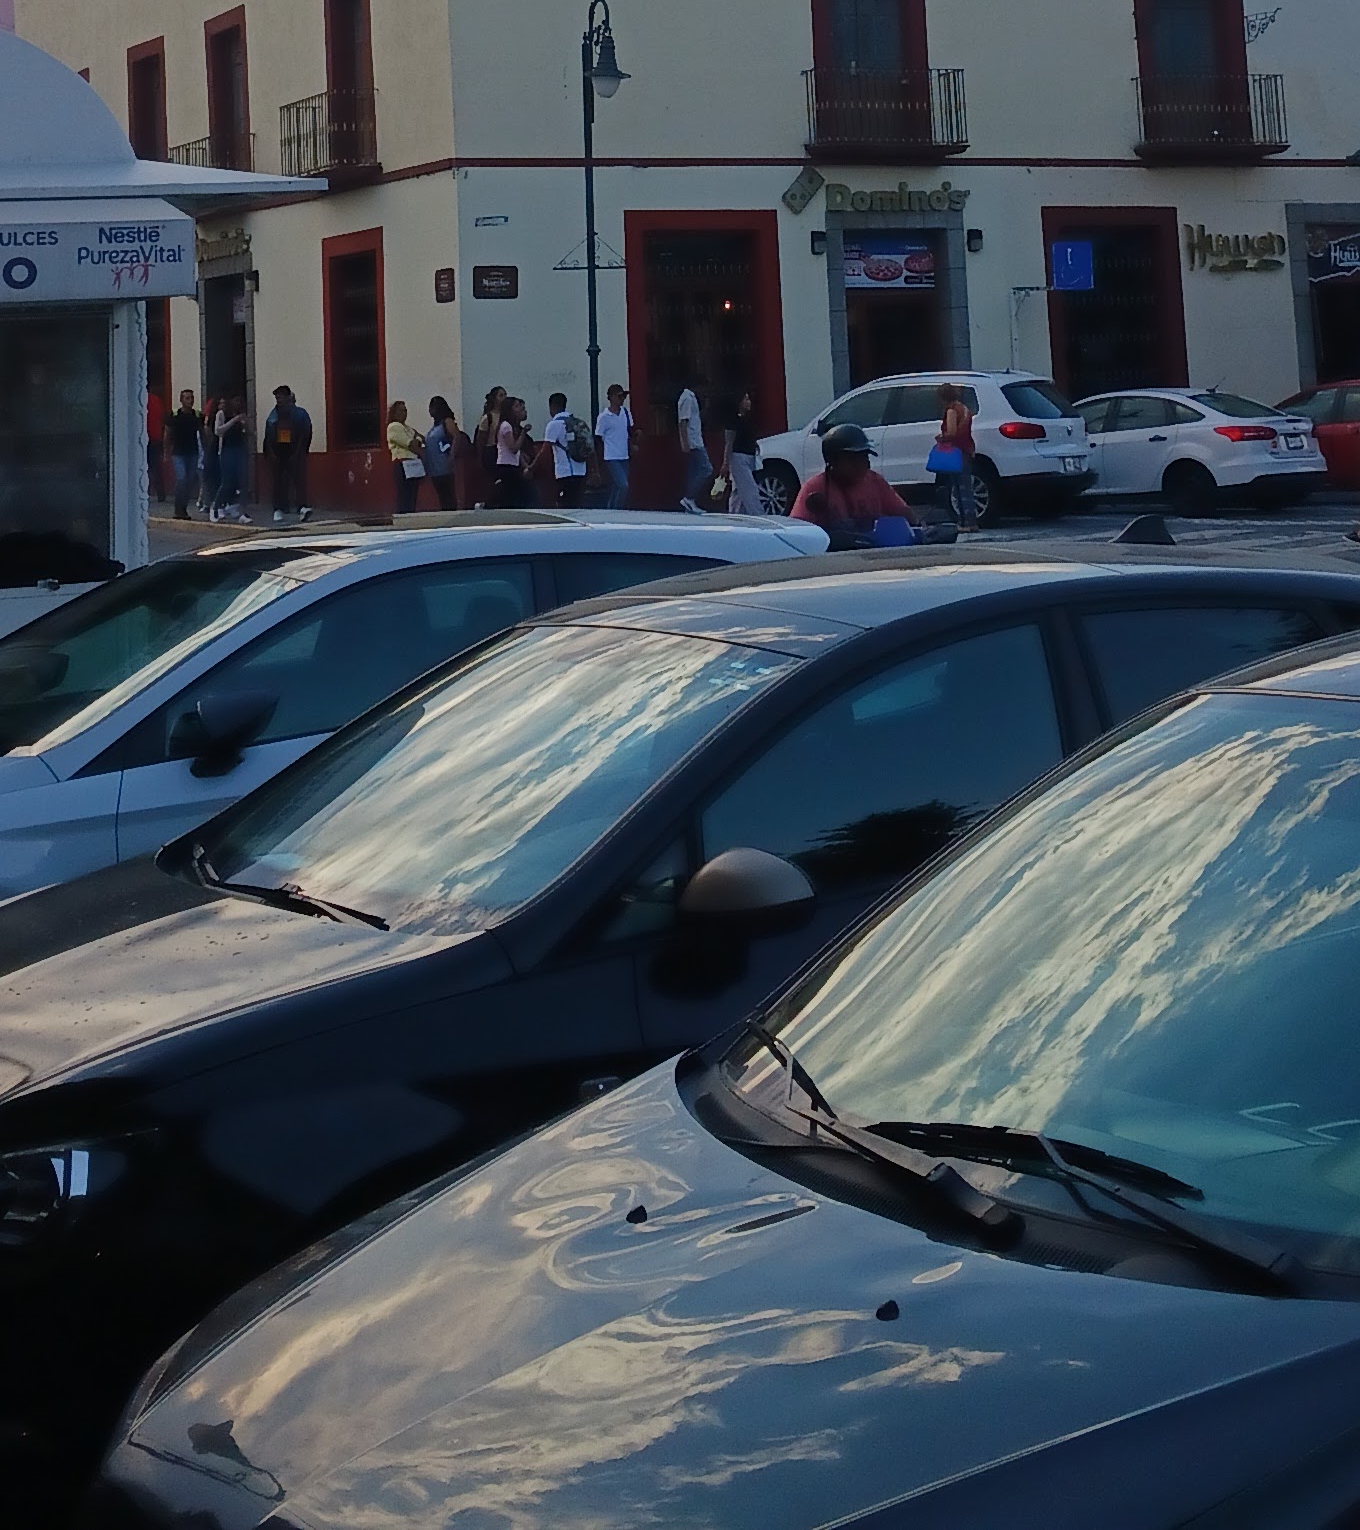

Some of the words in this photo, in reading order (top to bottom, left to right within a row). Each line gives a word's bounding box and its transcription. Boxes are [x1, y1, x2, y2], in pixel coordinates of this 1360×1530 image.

[826, 181, 968, 211] Domino's
[98, 225, 160, 244] Nestlé
[77, 244, 183, 265] PurezaVital
